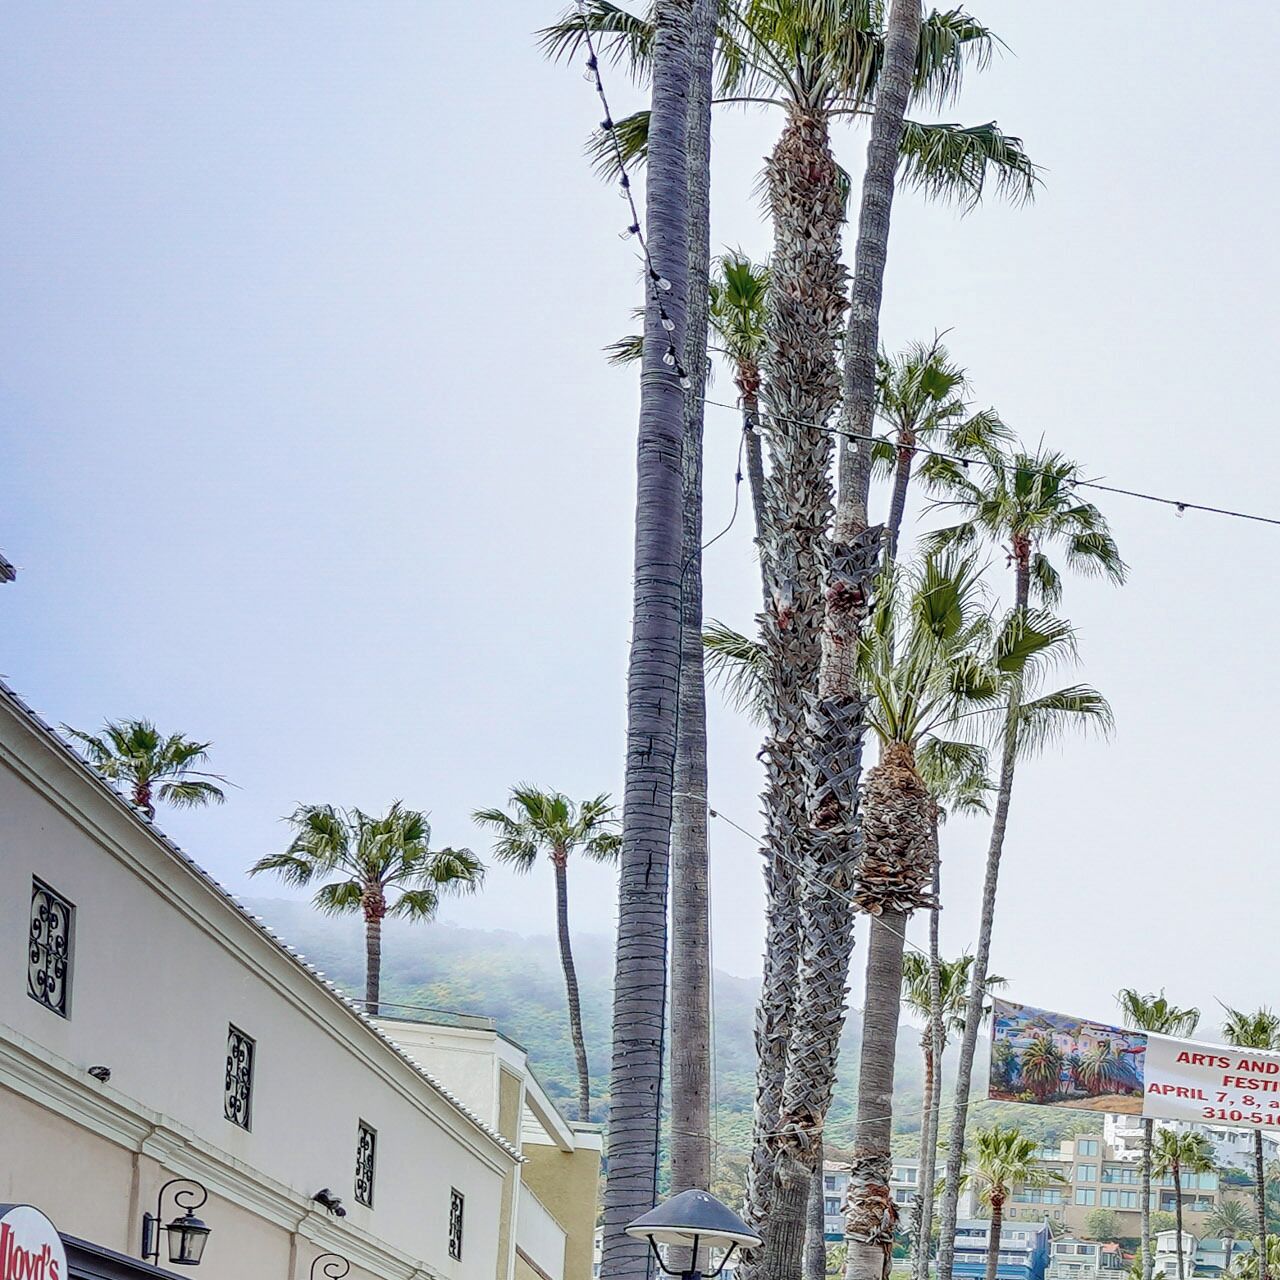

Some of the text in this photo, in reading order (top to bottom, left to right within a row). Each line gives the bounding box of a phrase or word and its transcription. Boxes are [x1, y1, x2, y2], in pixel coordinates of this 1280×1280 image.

[1176, 1051, 1230, 1068] ARTS
[1236, 1059, 1280, 1075] AND
[1148, 1083, 1208, 1101] APRIL
[1215, 1091, 1235, 1106] 7,
[1241, 1094, 1261, 1109] 8,
